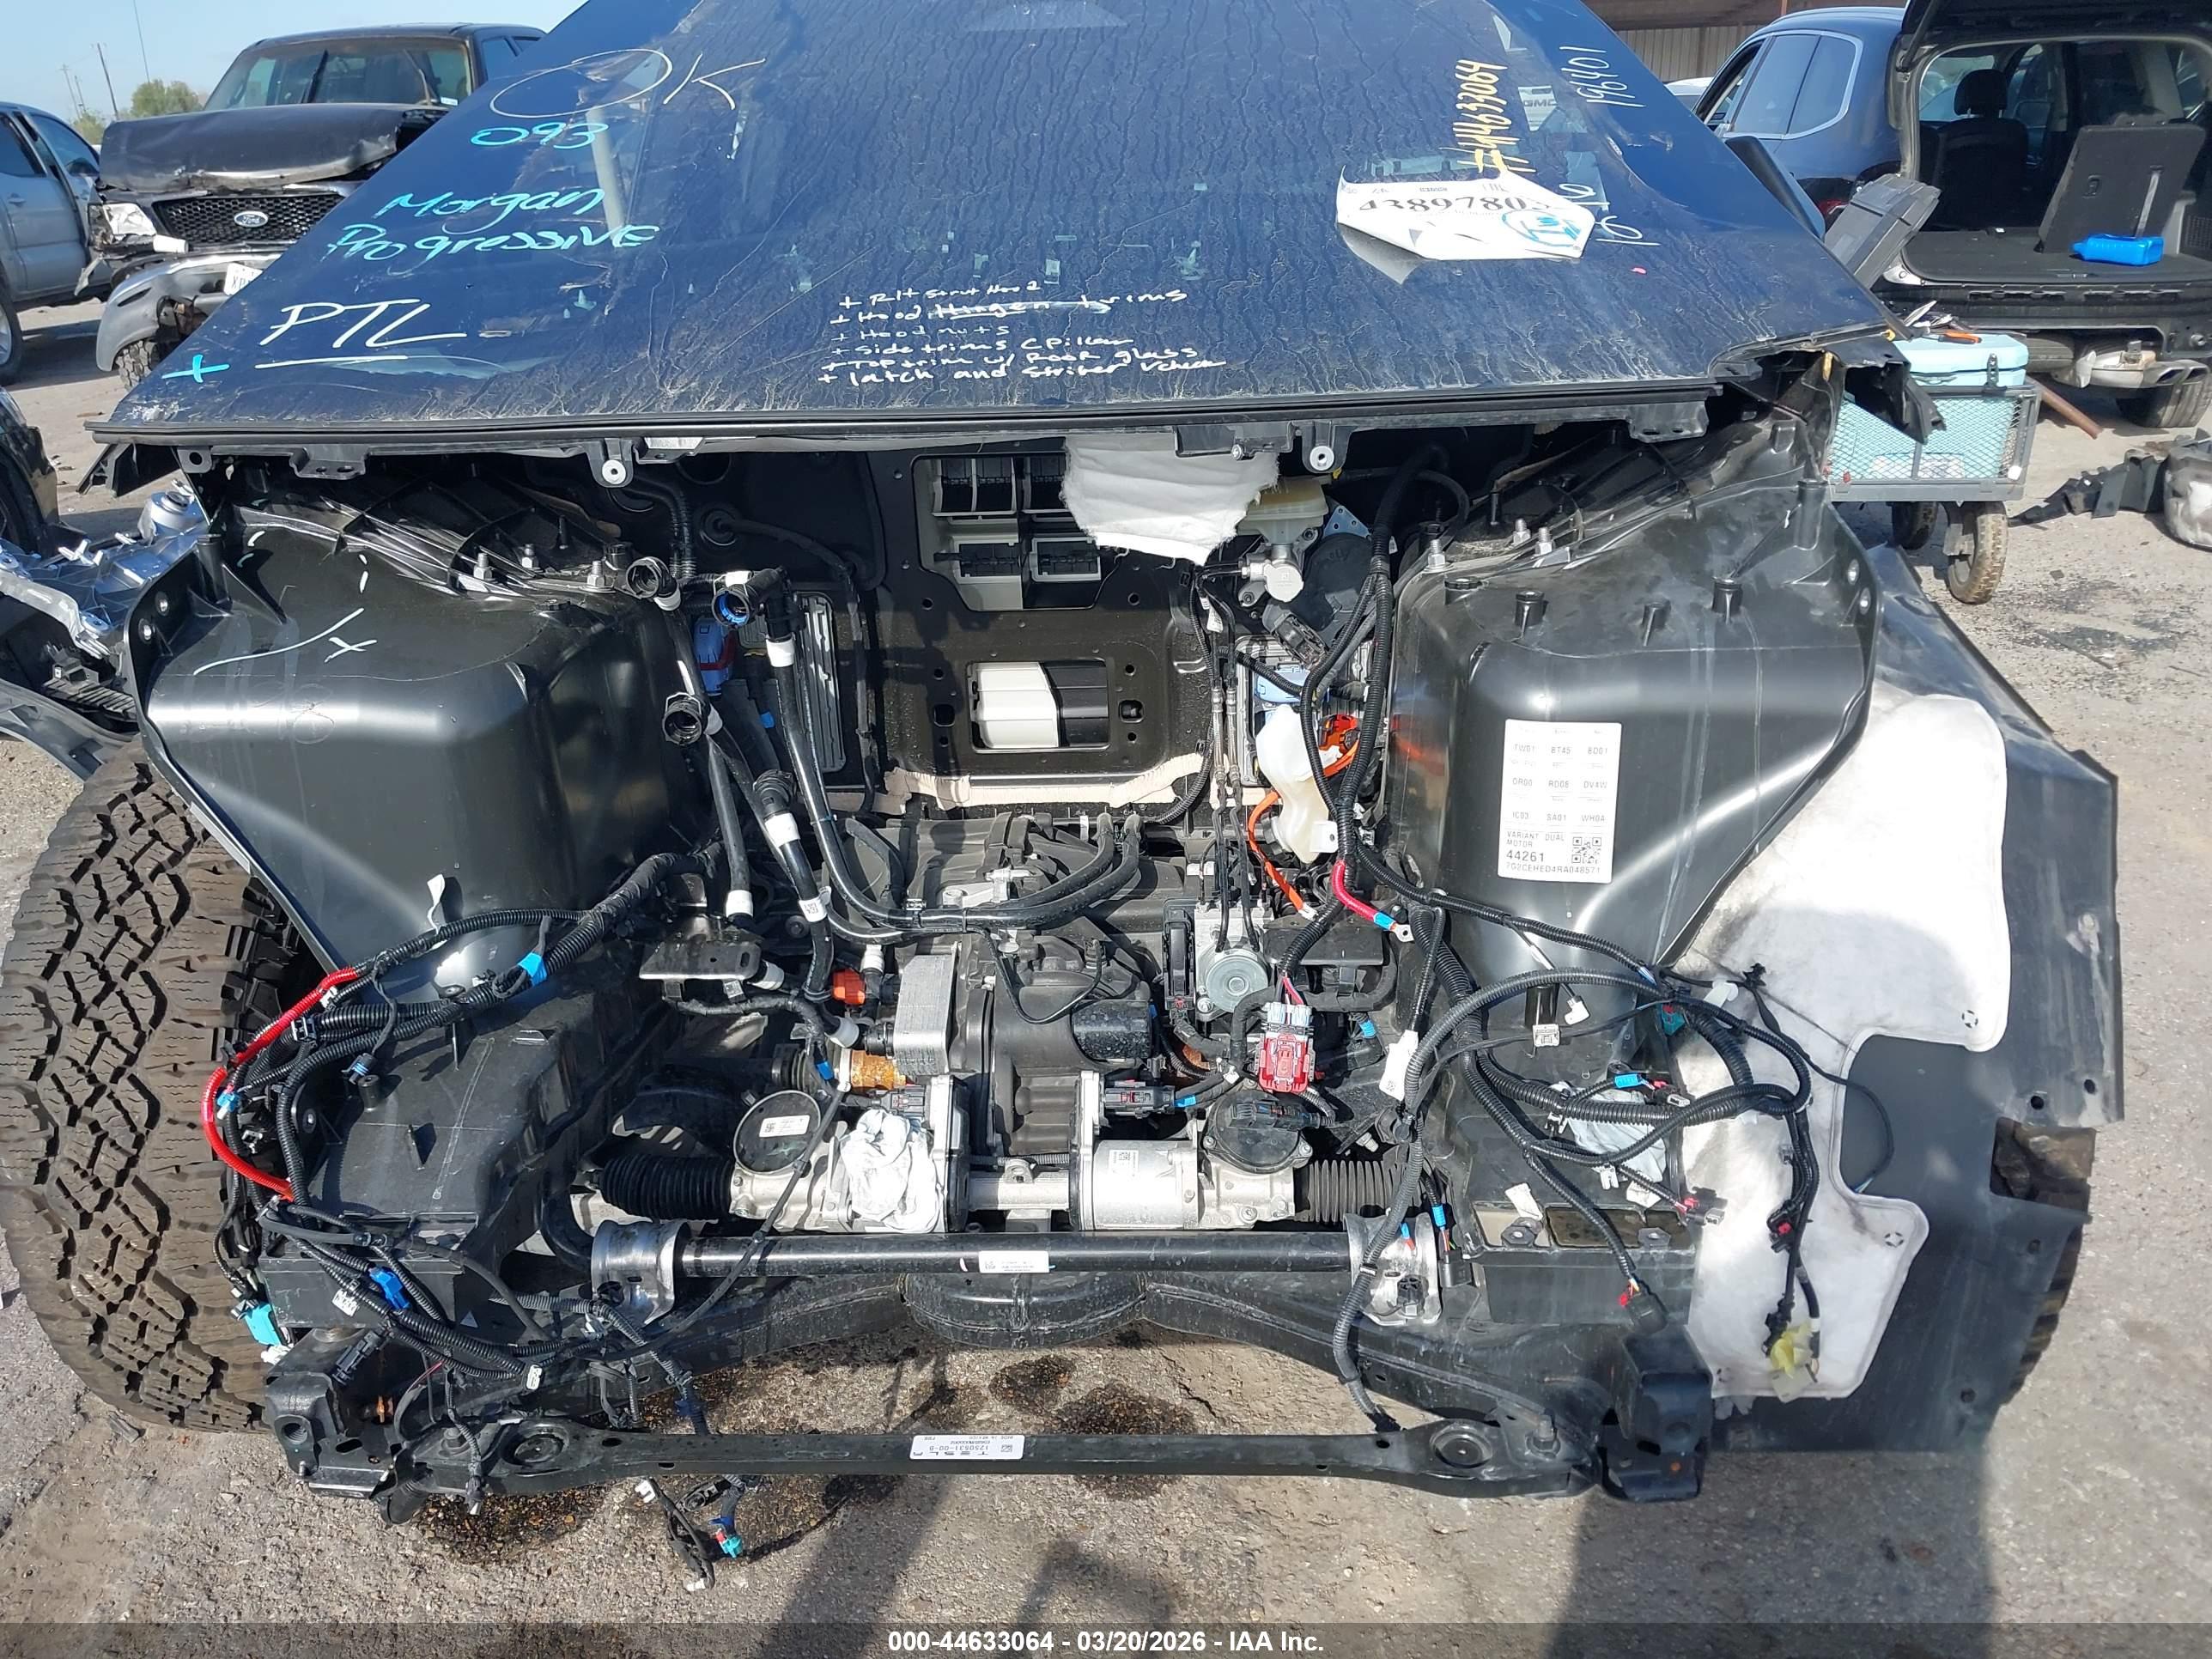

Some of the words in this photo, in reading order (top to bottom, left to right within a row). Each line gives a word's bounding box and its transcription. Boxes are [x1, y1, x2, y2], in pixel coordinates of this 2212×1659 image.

[1559, 46, 1646, 107] 196401
[242, 215, 260, 224] Ford
[373, 188, 605, 234] Morgan
[859, 305, 921, 323] Hood
[260, 299, 467, 349] PTL
[860, 325, 926, 340] Hood
[938, 325, 1010, 336] nuts
[849, 369, 933, 386] latch
[953, 363, 1007, 380] and
[1507, 831, 1539, 840] VARIANT
[1506, 850, 1545, 862] 44261
